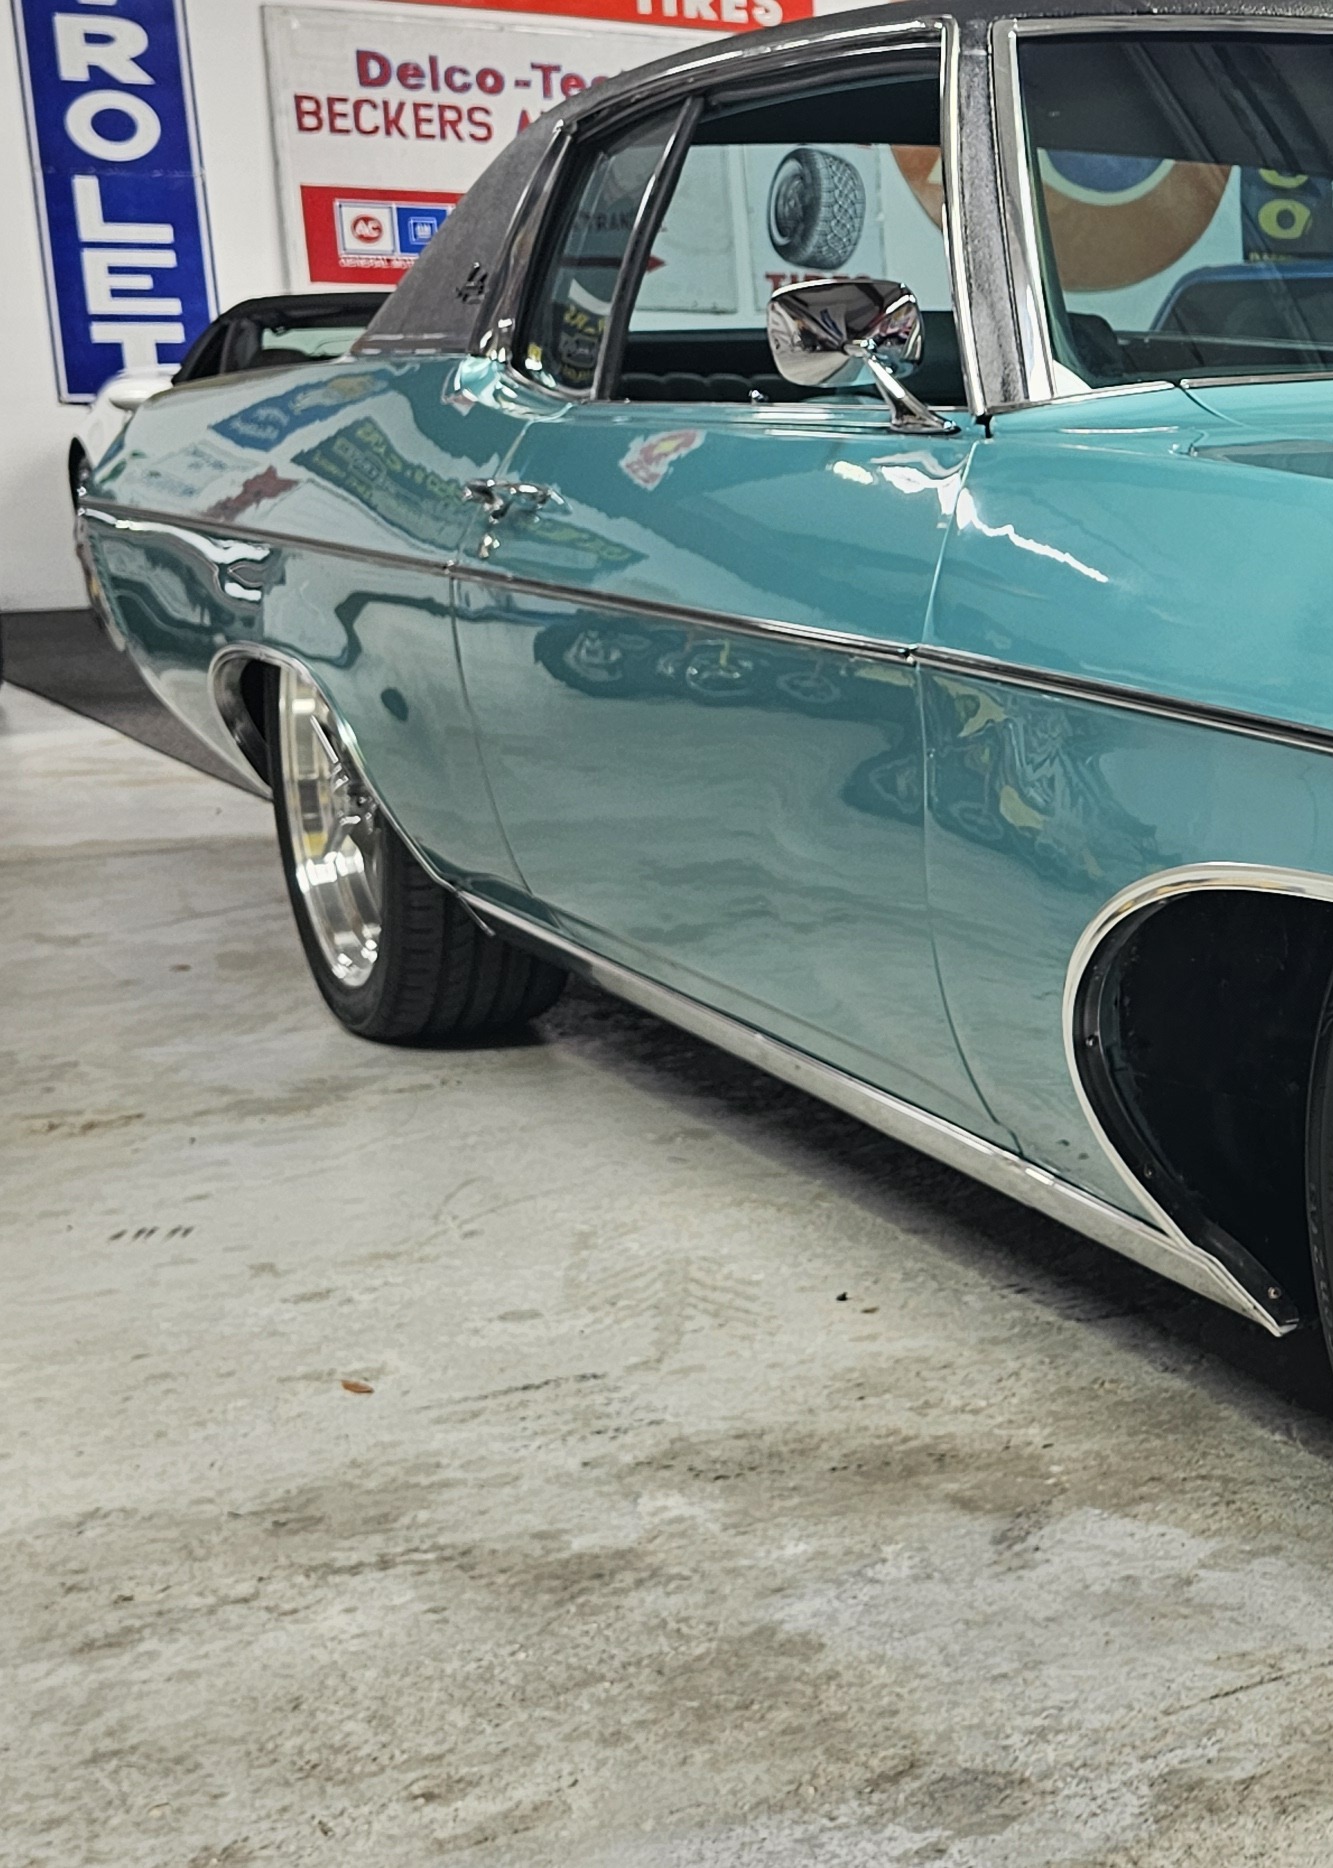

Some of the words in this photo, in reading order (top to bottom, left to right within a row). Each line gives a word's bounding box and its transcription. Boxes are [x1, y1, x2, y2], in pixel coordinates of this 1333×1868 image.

[294, 93, 494, 143] BECKERS
[53, 0, 186, 378] ROLET
[354, 219, 382, 238] AC
